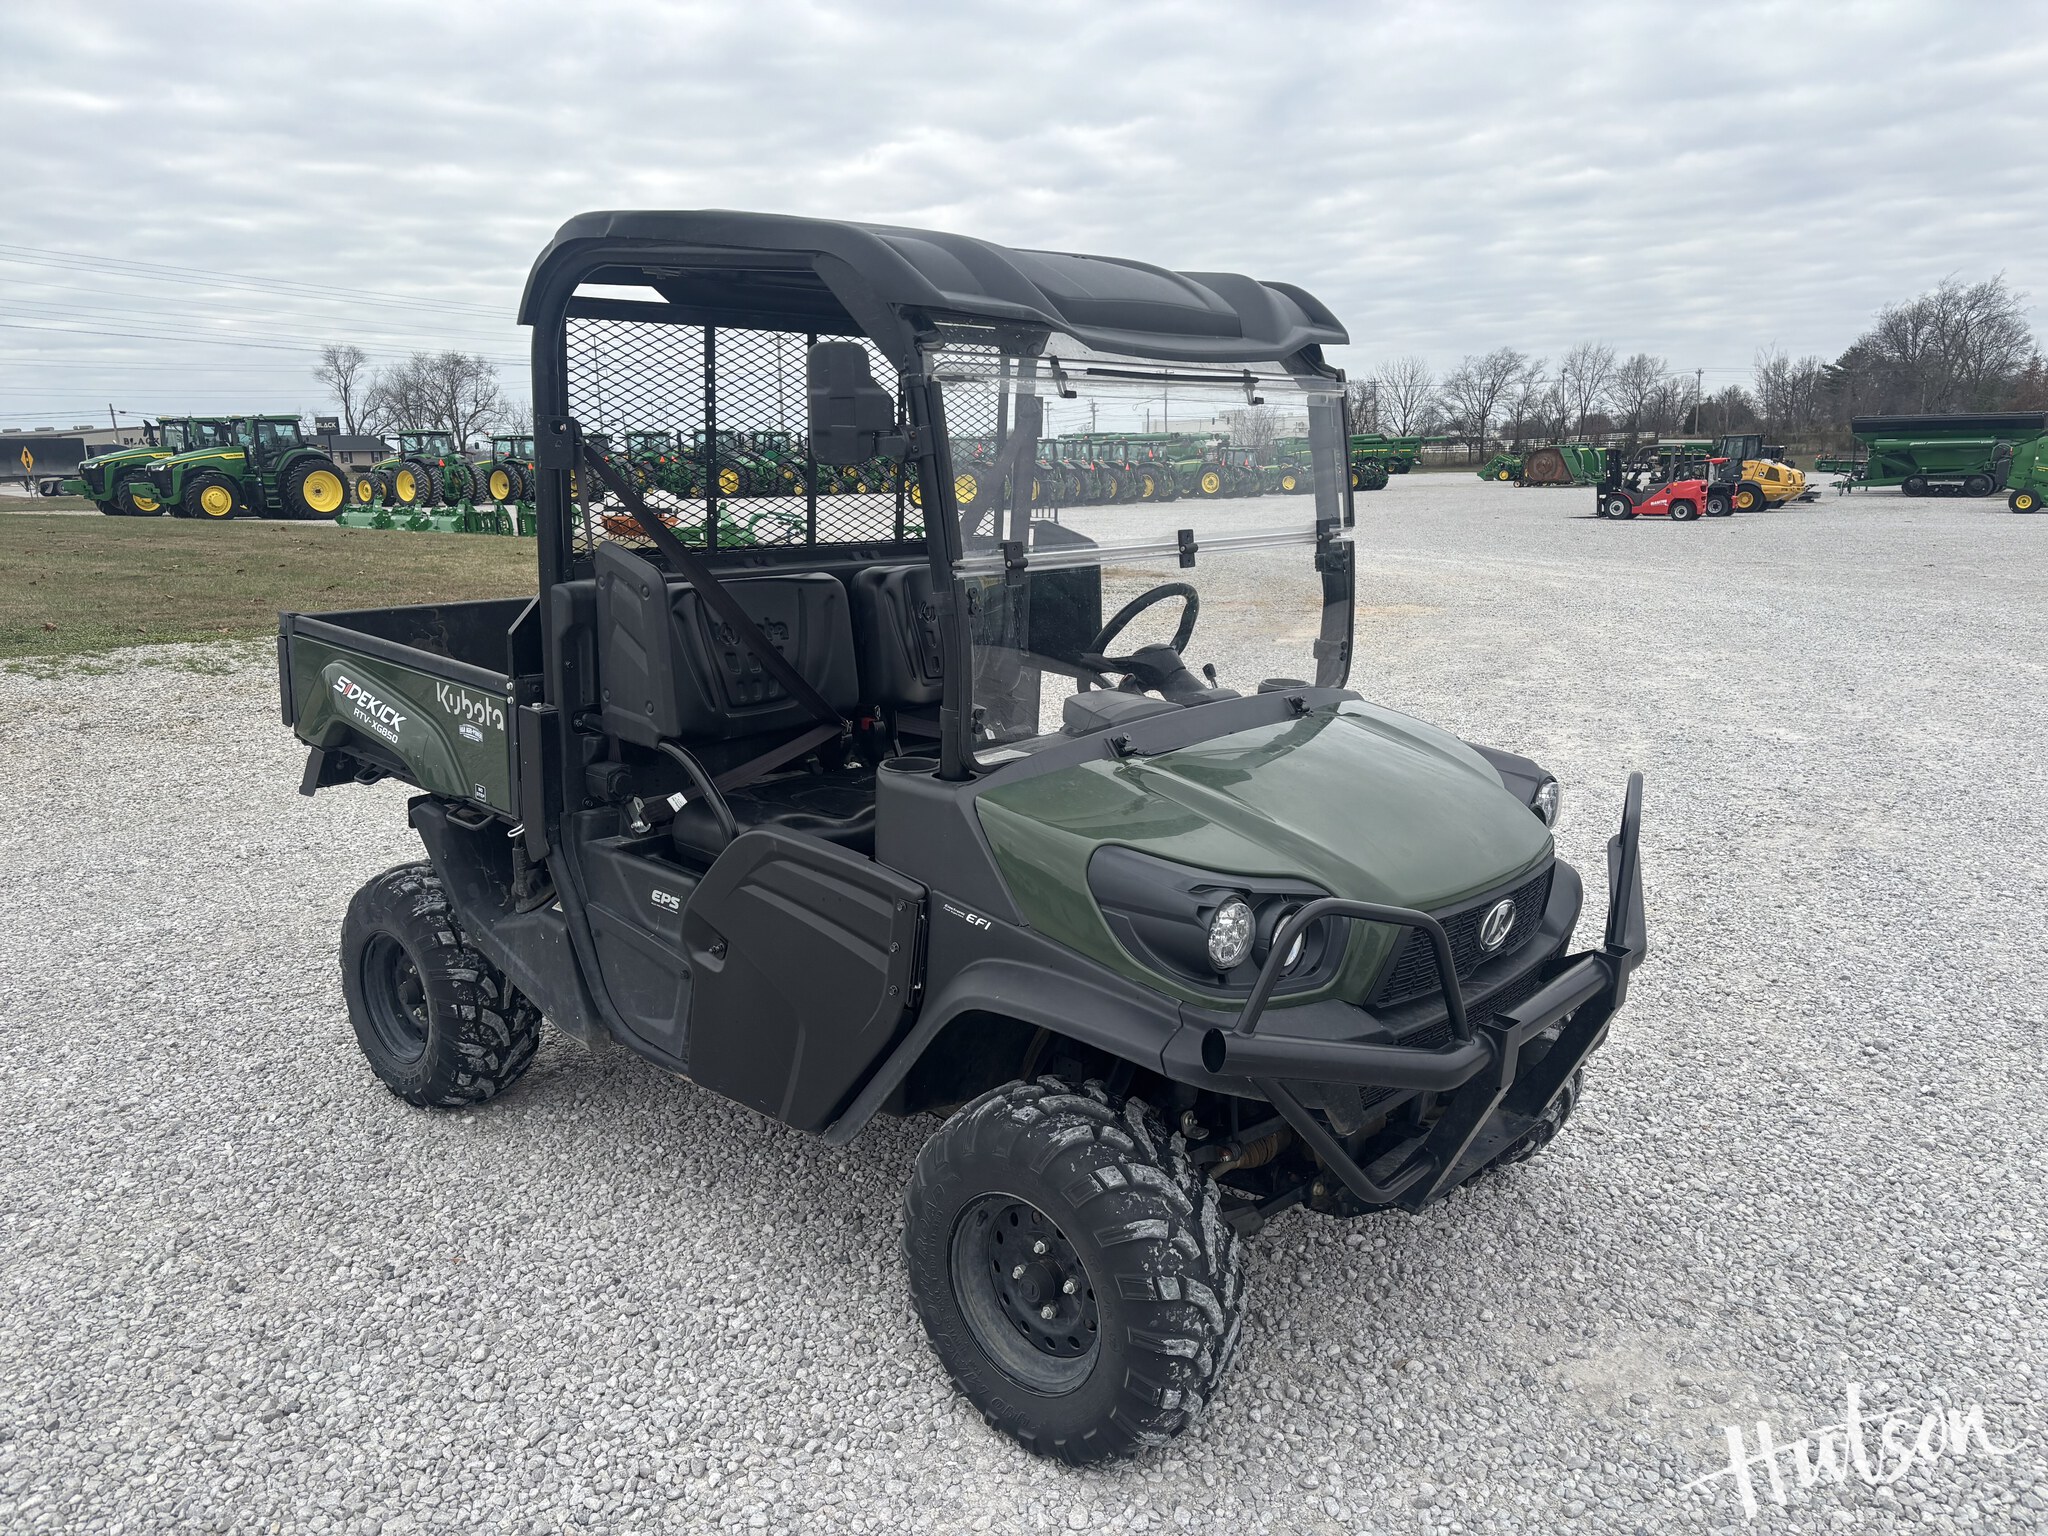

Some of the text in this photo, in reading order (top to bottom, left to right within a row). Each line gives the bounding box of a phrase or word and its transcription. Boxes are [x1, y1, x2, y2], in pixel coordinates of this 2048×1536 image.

[332, 675, 407, 733] SIDEKICK
[436, 681, 505, 731] Kubota
[353, 707, 399, 744] RTV-XG850
[651, 889, 681, 910] EPS
[965, 913, 992, 931] EFI
